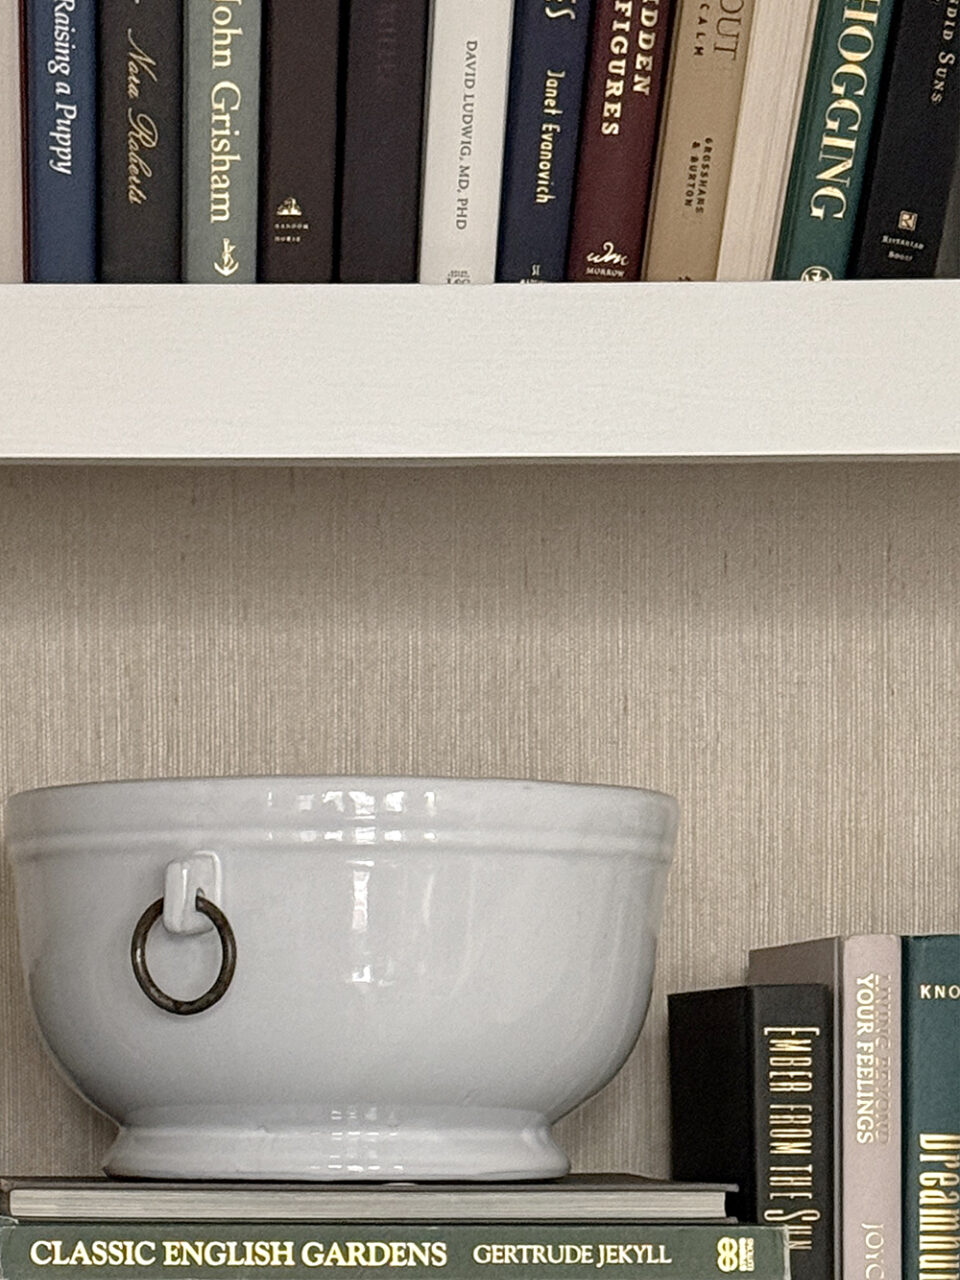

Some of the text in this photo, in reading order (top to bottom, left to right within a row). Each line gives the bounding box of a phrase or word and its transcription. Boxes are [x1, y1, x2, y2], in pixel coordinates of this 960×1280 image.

[47, 0, 78, 175] Raising a Puppy
[127, 28, 159, 204] Nora Roberts
[601, 0, 632, 136] FIGURES
[210, 80, 243, 224] Grisham
[455, 40, 478, 231] DAVID LUDWIG, MD, PHD
[535, 70, 566, 204] Janet Evanovich
[684, 155, 699, 207] BURTON
[695, 137, 714, 214] GROSSHANS
[586, 267, 624, 277] MORROW
[763, 1026, 821, 1092] EMBER
[856, 974, 875, 1144] YOUR FEELINGS
[769, 1104, 813, 1155] FROM
[769, 1164, 813, 1200] THE
[29, 1239, 673, 1268] CLASSIC ENGLISH GARDENS GERTRUDE JEKYLL
